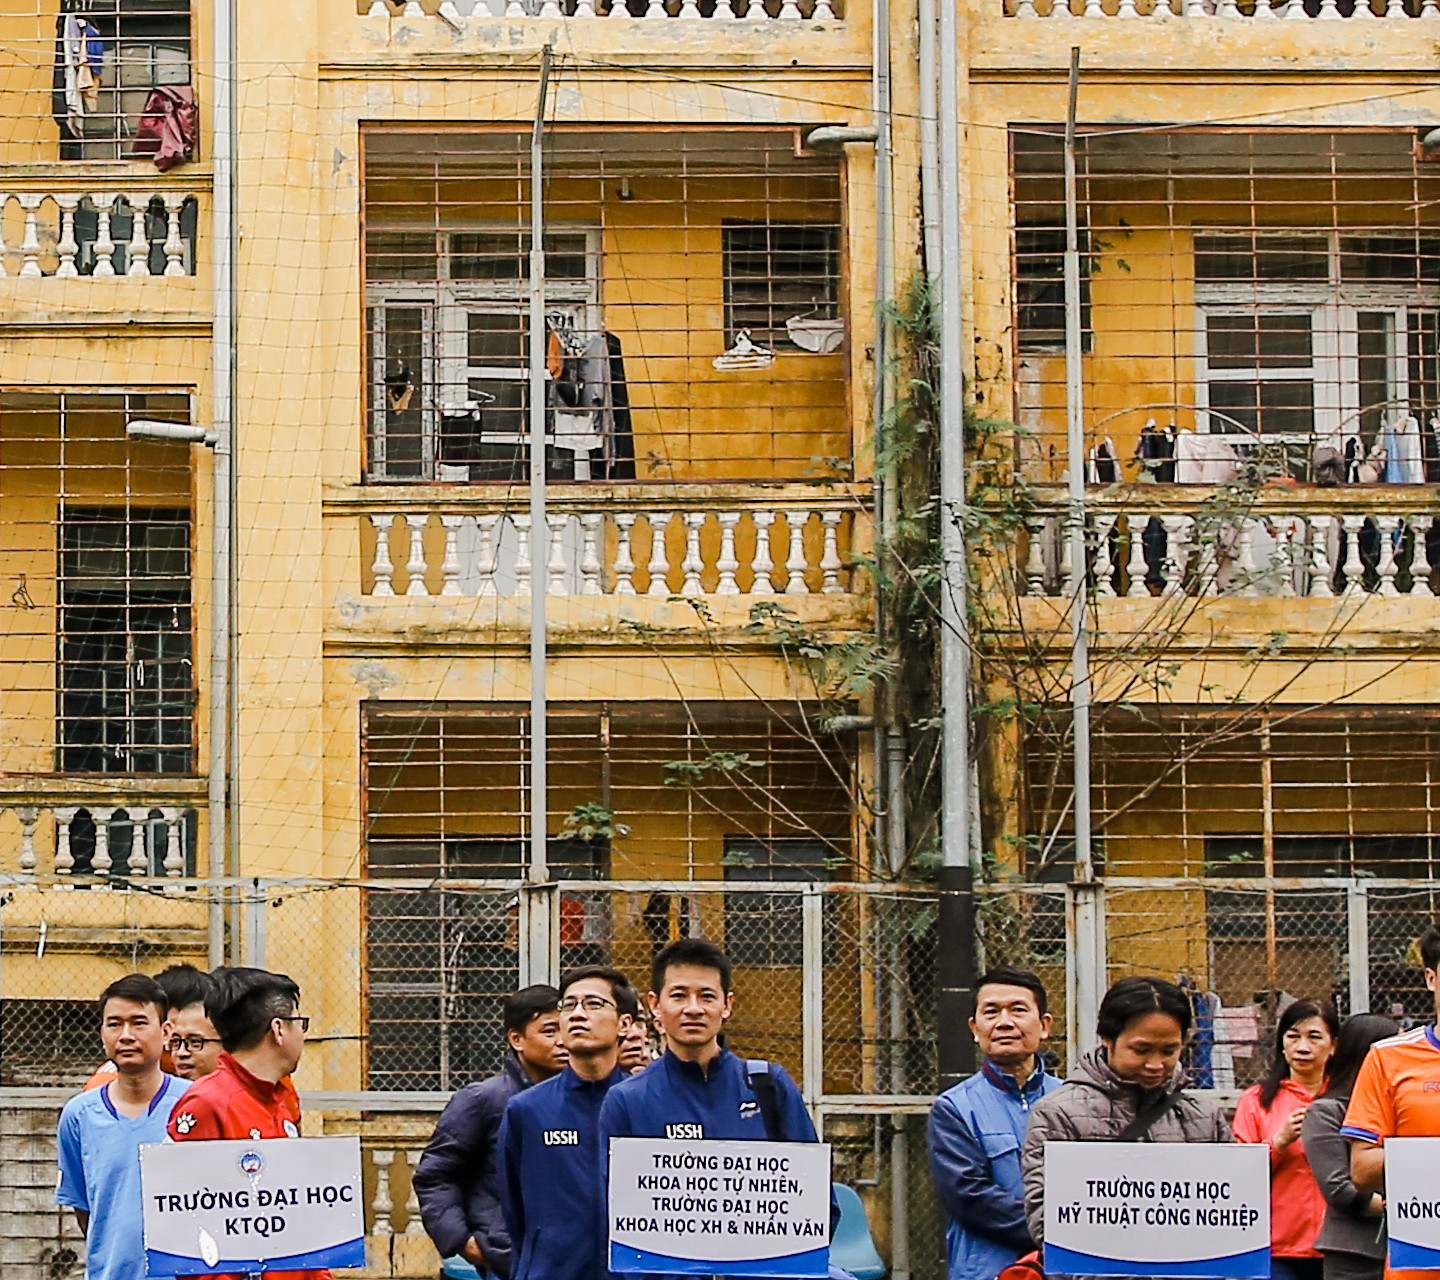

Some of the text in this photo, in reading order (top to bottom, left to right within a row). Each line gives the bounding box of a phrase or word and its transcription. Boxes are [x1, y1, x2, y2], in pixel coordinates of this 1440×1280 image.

[544, 1131, 578, 1145] USSH
[666, 1124, 703, 1139] USSH
[653, 1151, 789, 1175] TRƯỜNG ĐẠI HỌC
[638, 1176, 803, 1196] KHOA HỌC TỰ NHIÊN,
[1087, 1175, 1230, 1203] TRƯỜNG ĐẠI HỌC
[154, 1185, 353, 1212] TRƯỜNG ĐẠI HỌC
[652, 1193, 788, 1217] TRƯỜNG ĐẠI HỌC
[225, 1216, 286, 1237] KTQD
[616, 1217, 659, 1232] KHOA
[664, 1219, 695, 1236] HỌC
[701, 1221, 722, 1233] XH
[728, 1221, 739, 1234] &
[793, 1219, 824, 1236] VĂN
[1058, 1202, 1259, 1230] MỸ THUẬT CÔNG NGHIỆP
